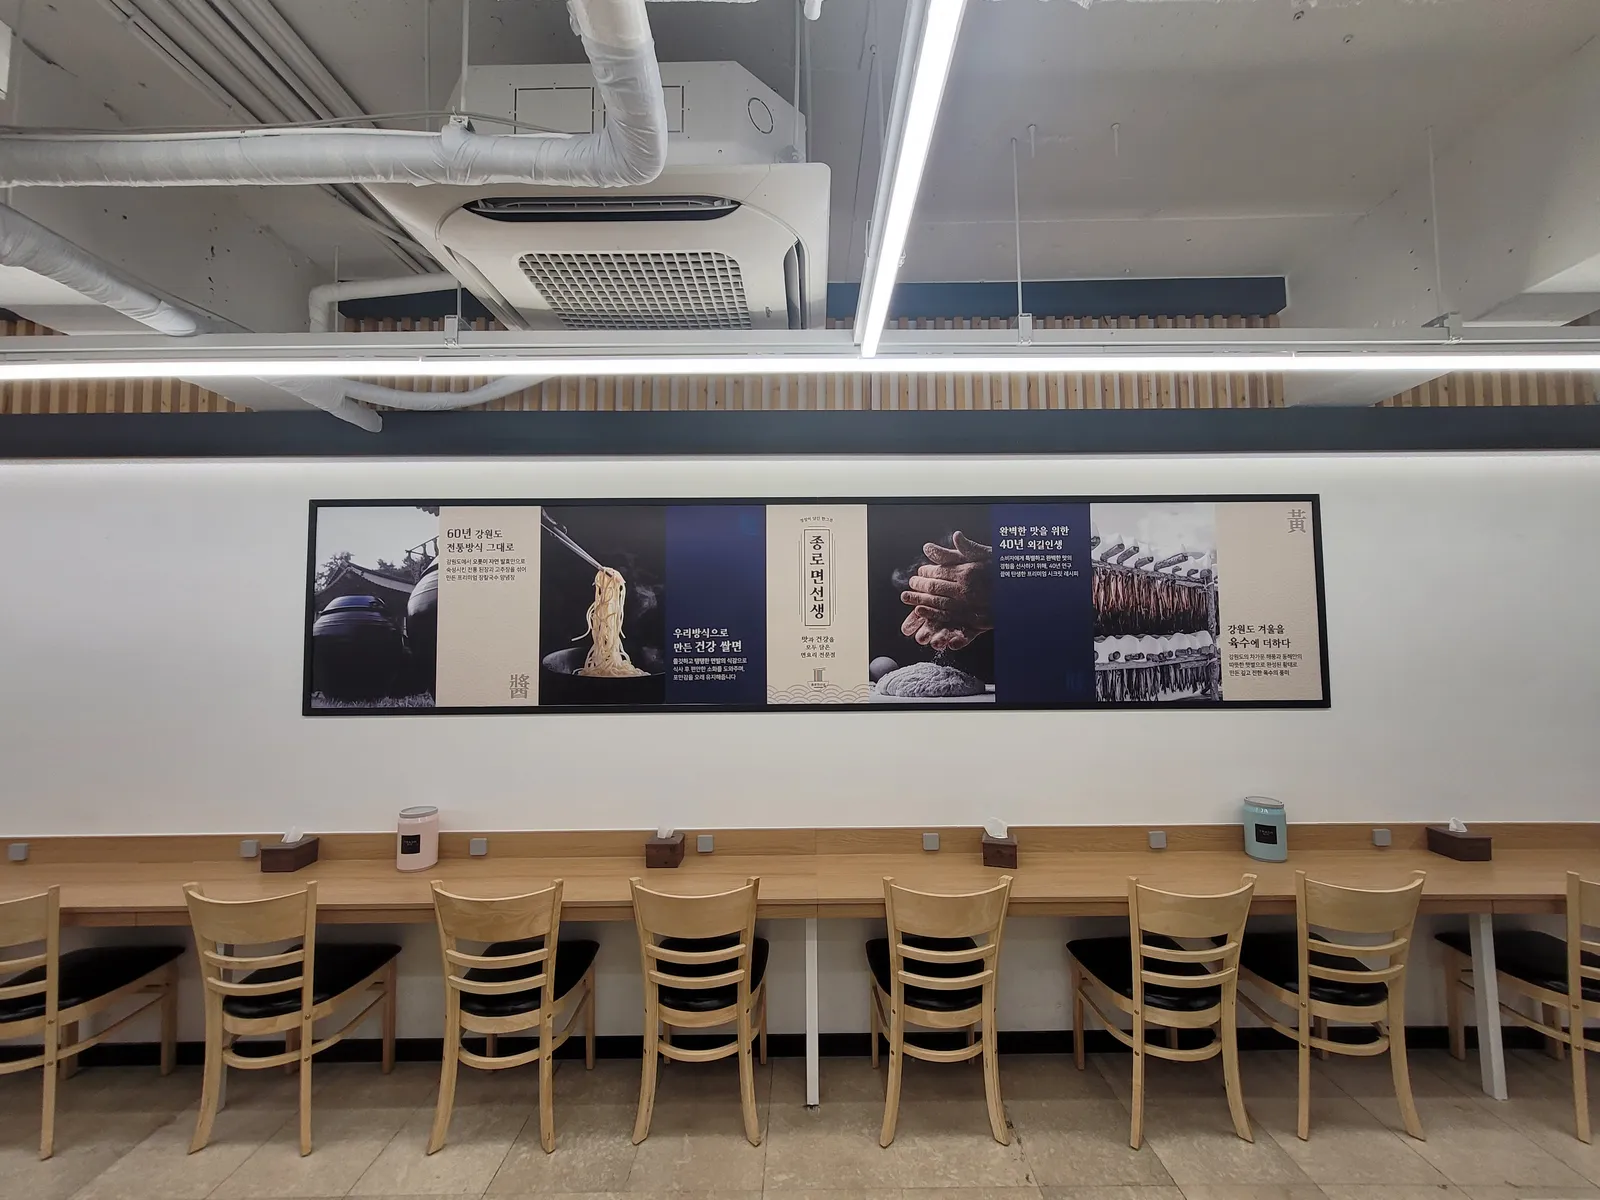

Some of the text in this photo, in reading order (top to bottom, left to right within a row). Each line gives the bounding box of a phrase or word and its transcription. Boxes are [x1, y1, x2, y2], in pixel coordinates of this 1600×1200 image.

[447, 528, 503, 539] 60년 강원도
[1000, 526, 1069, 536] 완벽한 맛을 위한
[447, 542, 514, 553] 전통방식 그대로
[1000, 538, 1062, 550] 40년 외길인생
[809, 536, 825, 619] 종로면선생
[673, 628, 729, 638] 우리방식으로
[1228, 624, 1285, 634] 강원도 겨울을
[674, 640, 742, 652] 만든 건강 쌀면
[1228, 637, 1291, 648] 육수에 더하다
